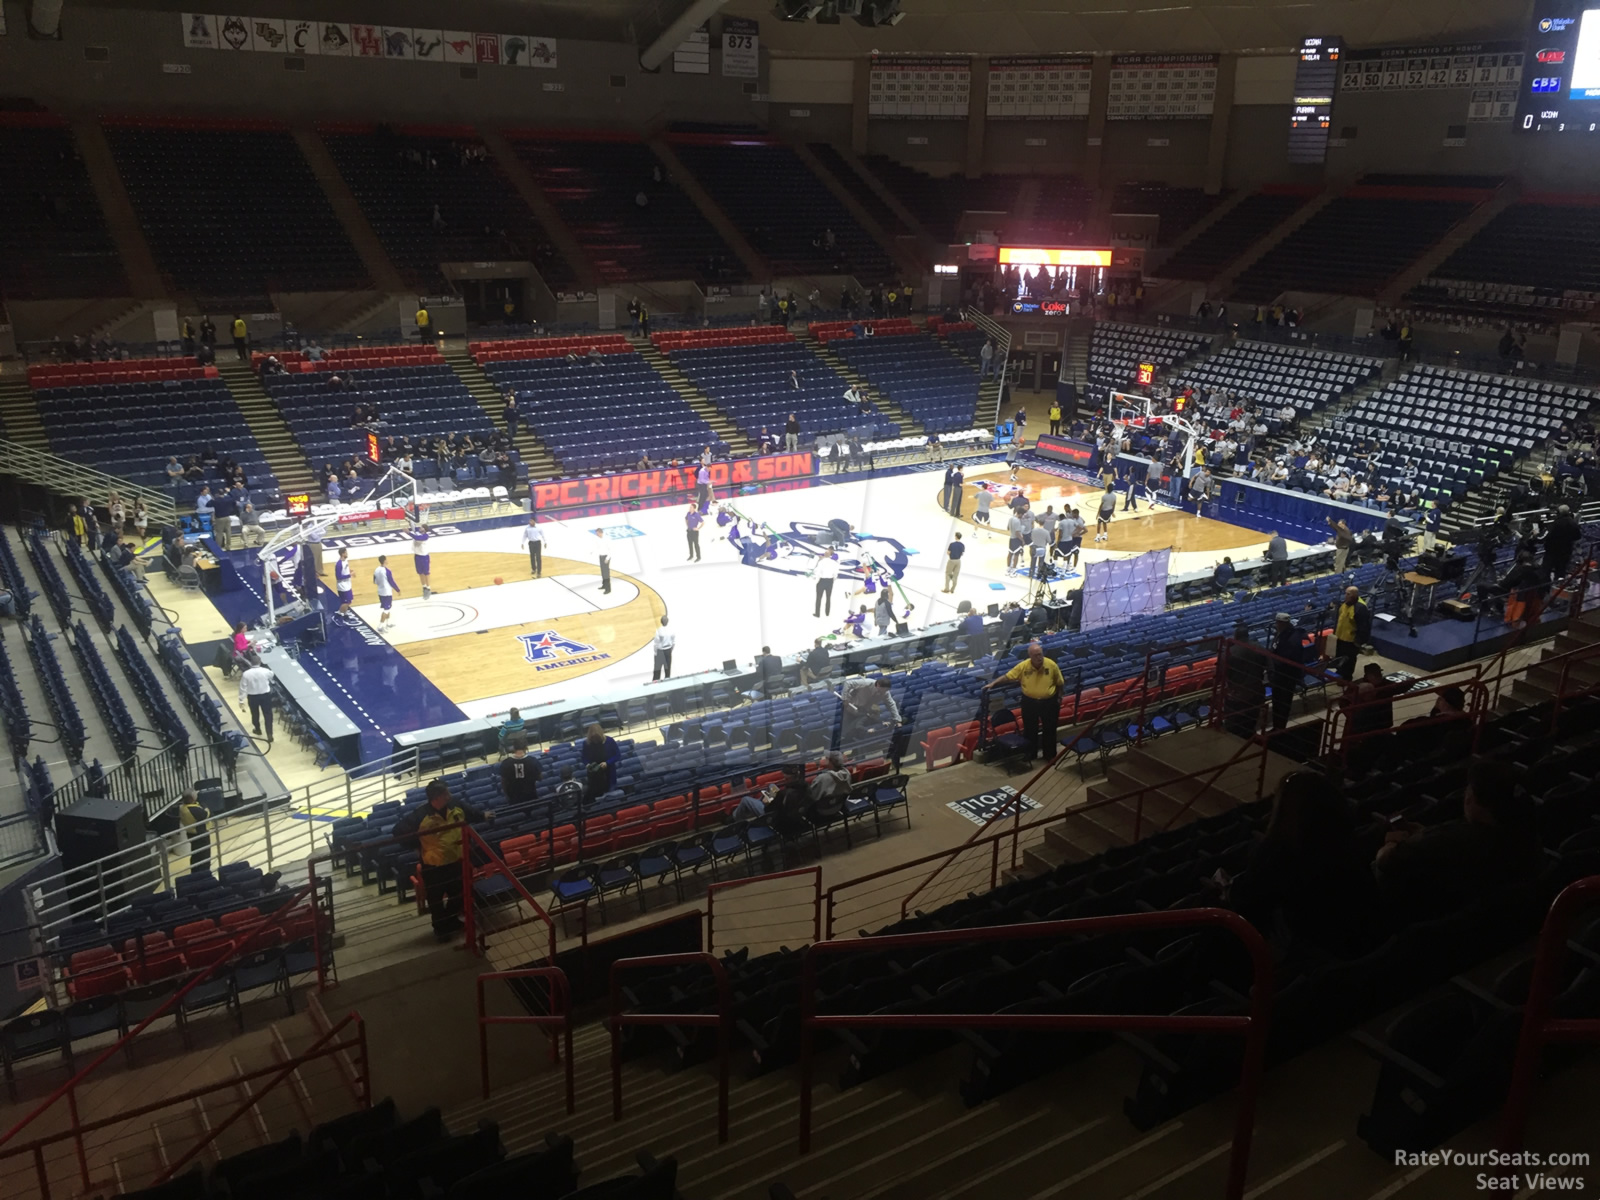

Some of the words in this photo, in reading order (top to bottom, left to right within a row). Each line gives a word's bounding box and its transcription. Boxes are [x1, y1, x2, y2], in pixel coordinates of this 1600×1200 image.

[728, 36, 753, 49] 873
[1145, 54, 1213, 63] CHAMPIONSHIP
[1344, 75, 1358, 86] 24
[1364, 74, 1379, 86] 50
[1388, 73, 1400, 84] 21
[1408, 72, 1422, 84] 52
[1430, 71, 1445, 83] 42
[1455, 70, 1468, 82] 25
[1541, 111, 1559, 119] UCONN
[1523, 114, 1534, 129] 0
[1558, 123, 1565, 132] 3
[1041, 300, 1066, 311] Coke
[1139, 371, 1152, 384] 30
[732, 461, 754, 484] &
[758, 453, 813, 482] SON
[535, 653, 612, 672] AMERICAN
[513, 763, 525, 779] 13
[960, 794, 999, 810] 110
[950, 803, 986, 825] 110-111
